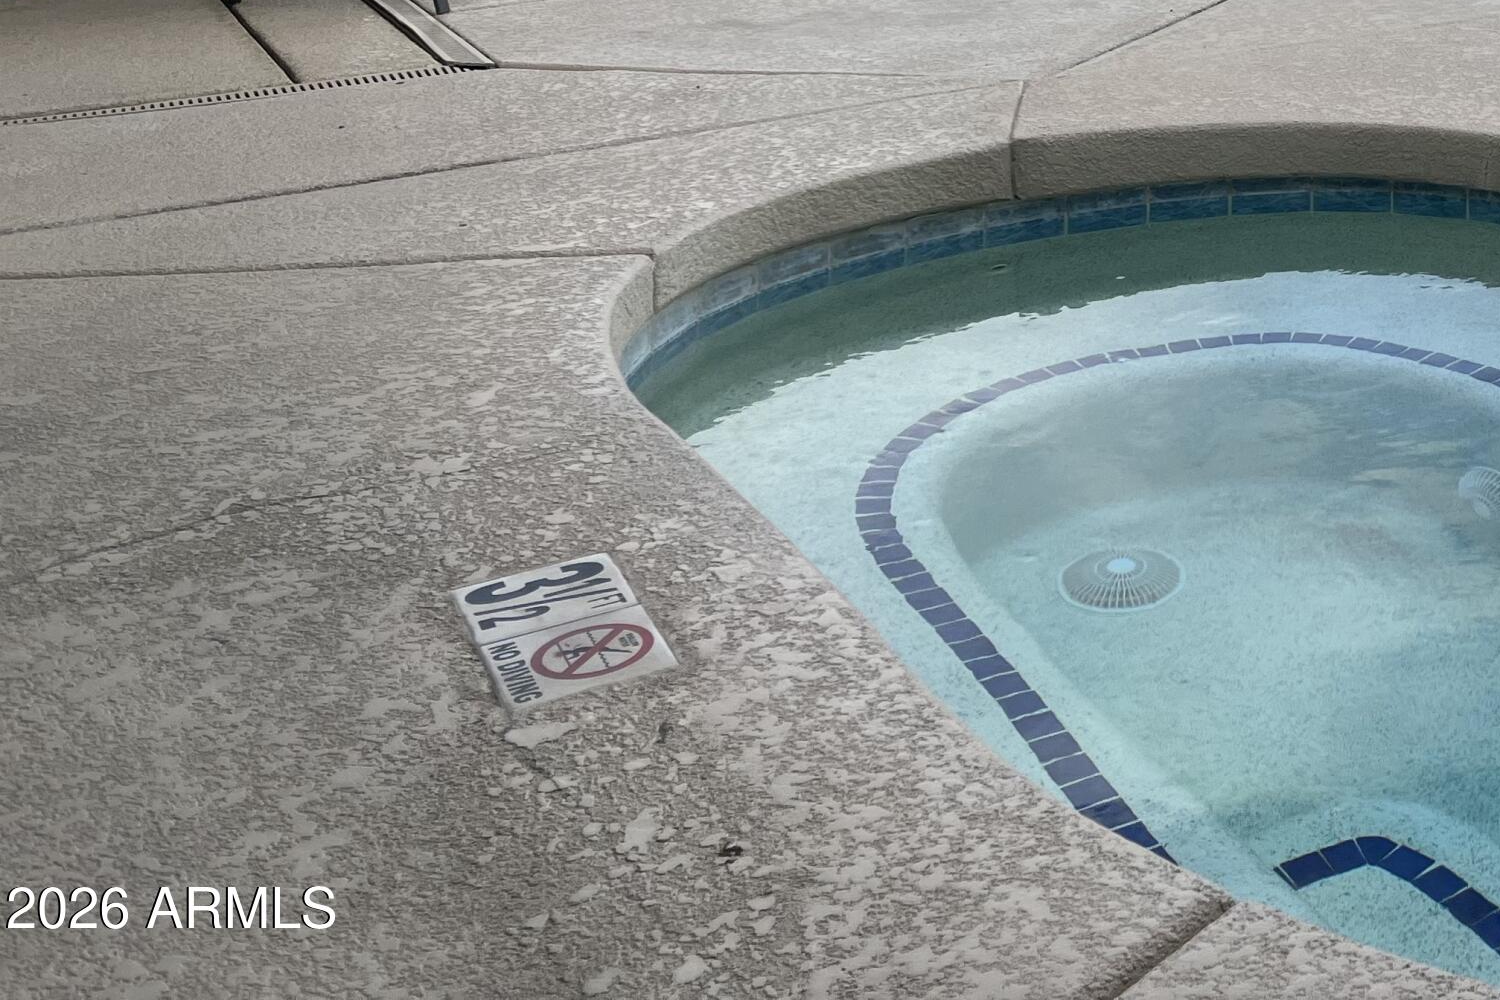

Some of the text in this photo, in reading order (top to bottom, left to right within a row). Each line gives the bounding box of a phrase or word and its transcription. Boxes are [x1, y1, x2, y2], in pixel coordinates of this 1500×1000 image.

[587, 587, 628, 610] FT
[488, 641, 544, 704] NO DIVING
